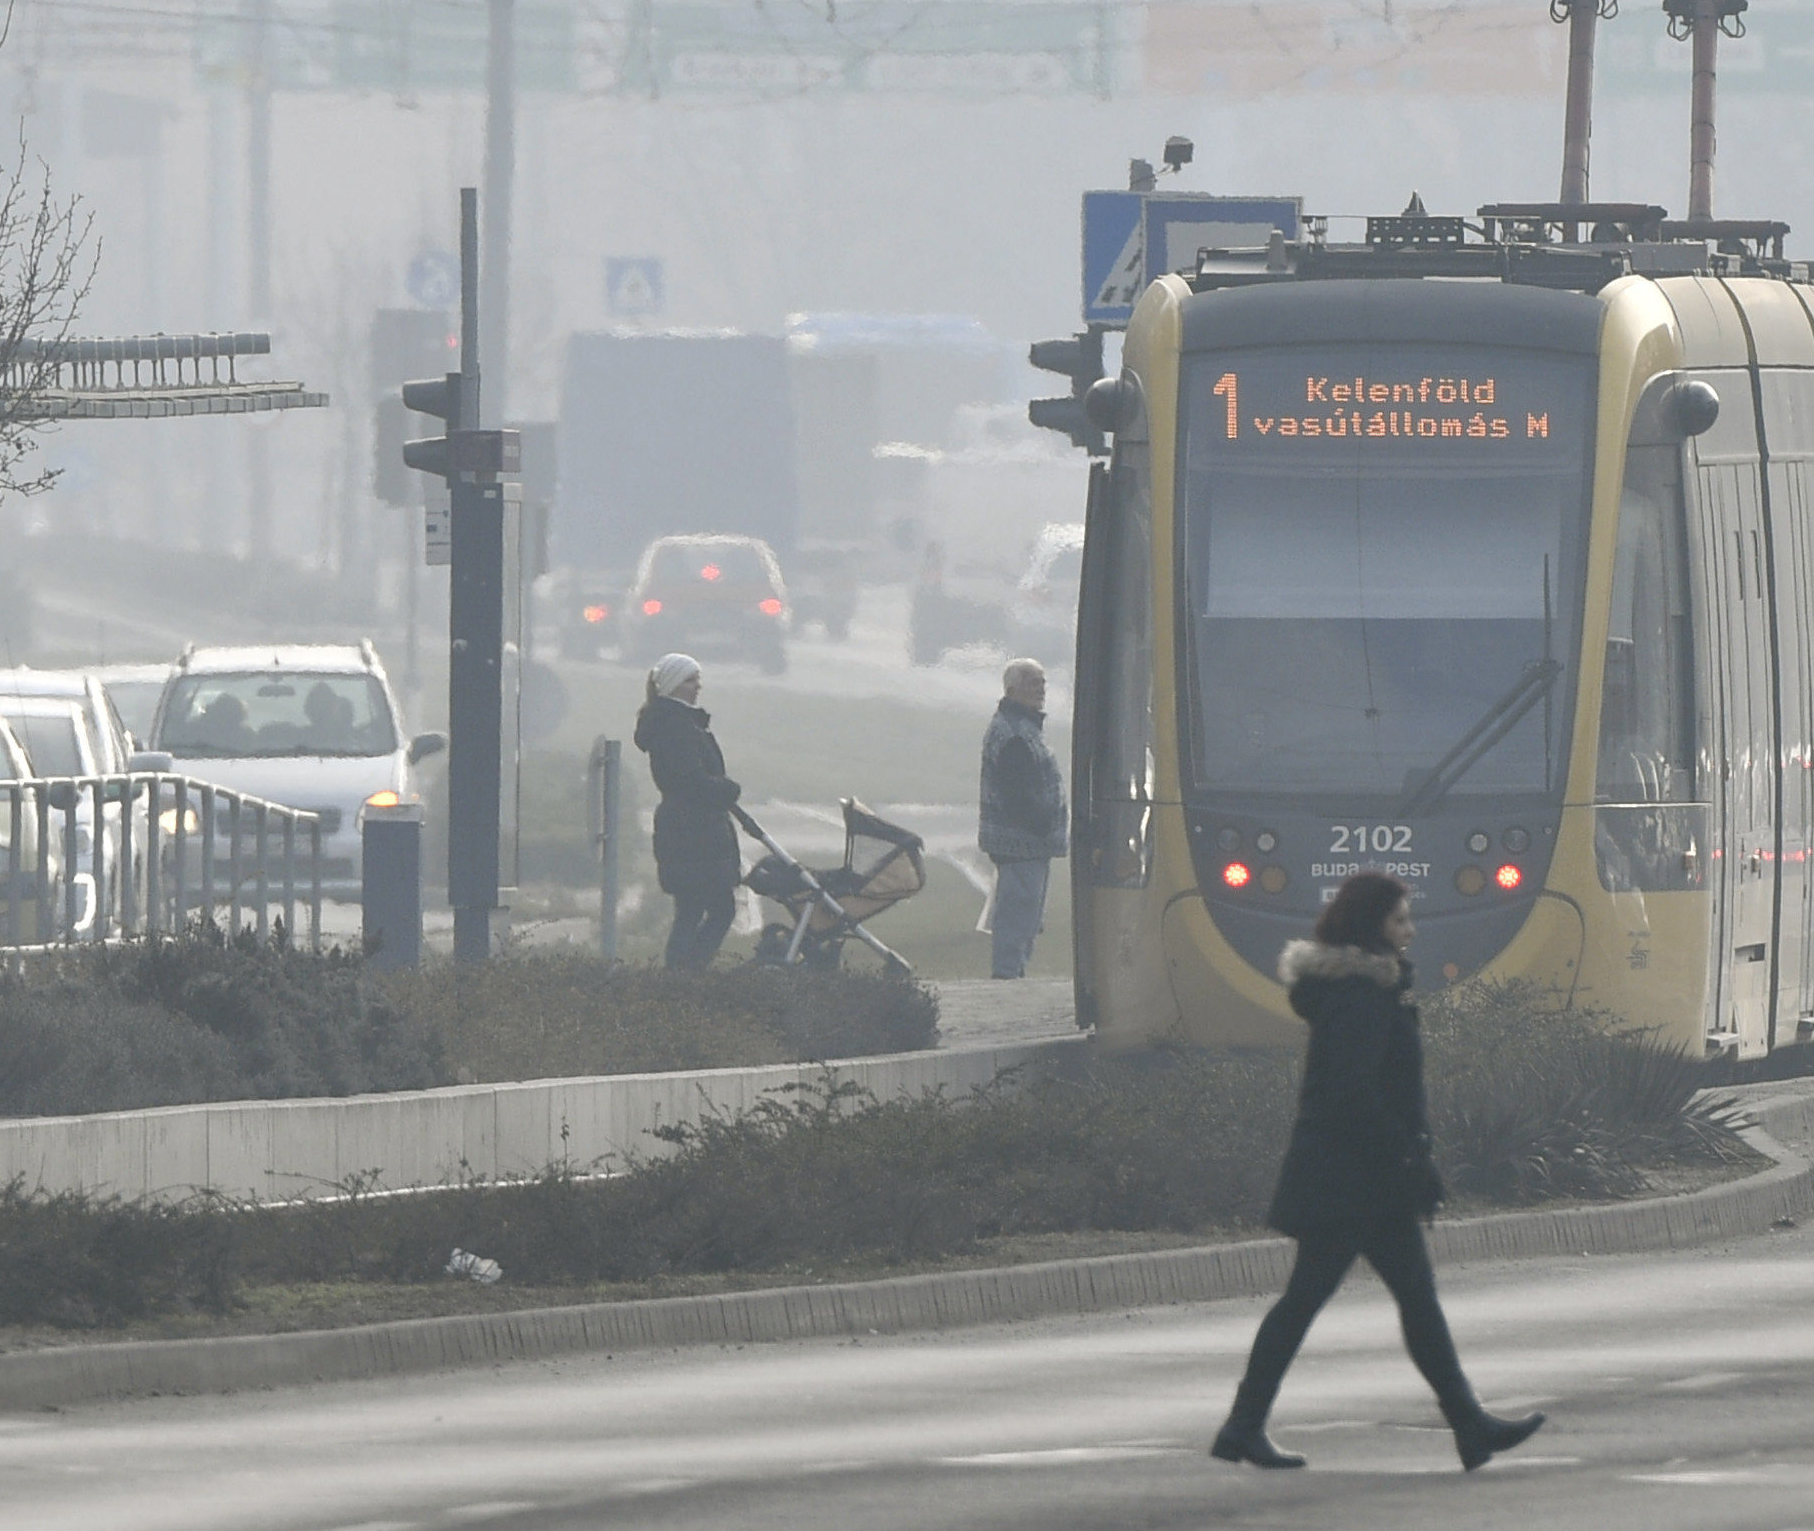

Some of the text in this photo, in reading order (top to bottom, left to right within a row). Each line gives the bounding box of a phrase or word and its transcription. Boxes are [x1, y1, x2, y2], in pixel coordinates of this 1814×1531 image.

[1306, 376, 1495, 404] Kelenföld
[1213, 373, 1238, 439] 1
[1253, 407, 1549, 437] vasútállomás M
[1330, 825, 1412, 853] 2102
